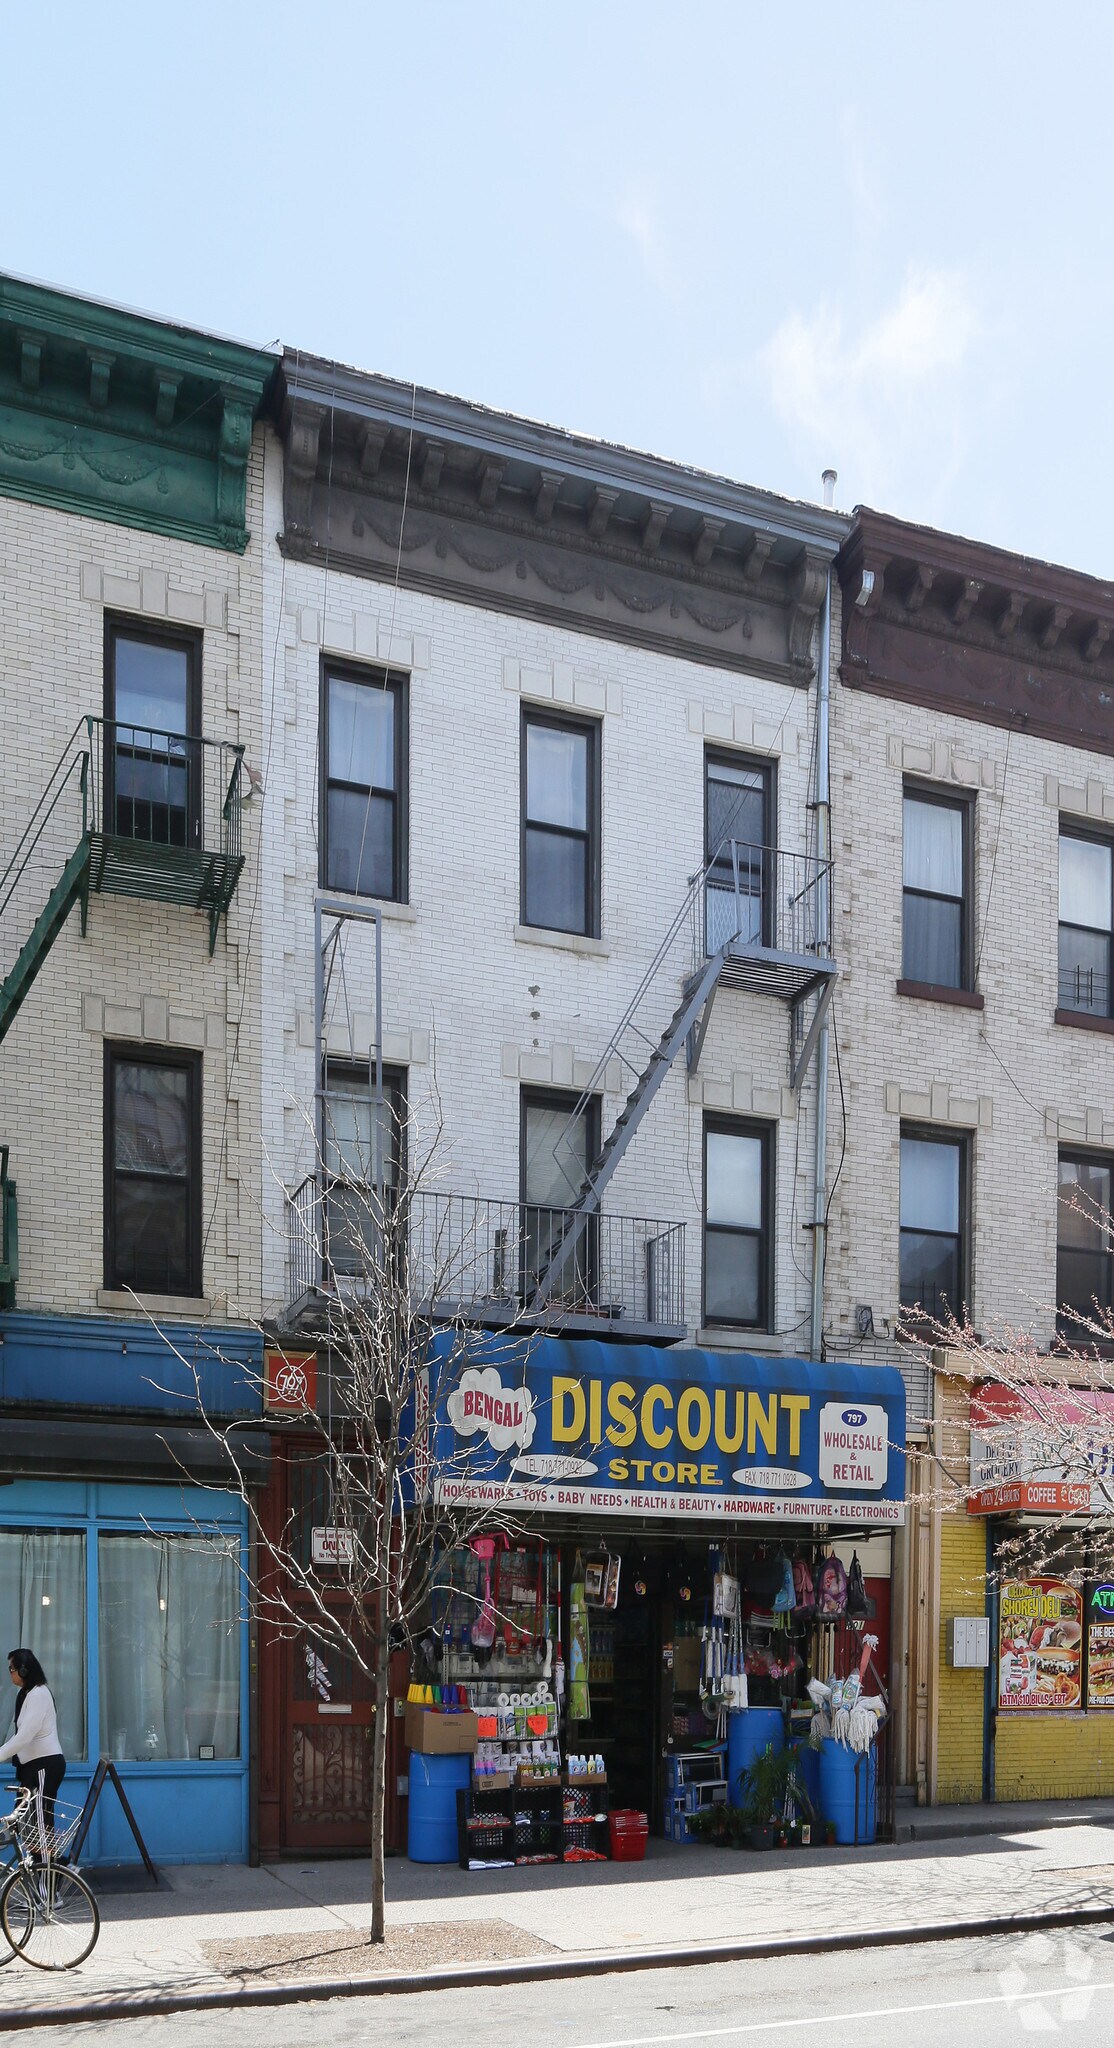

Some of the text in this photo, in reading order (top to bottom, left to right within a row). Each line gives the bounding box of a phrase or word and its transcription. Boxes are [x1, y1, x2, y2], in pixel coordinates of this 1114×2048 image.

[464, 1391, 523, 1428] BENGAL
[552, 1376, 811, 1456] DISCOUNT
[847, 1413, 862, 1424] 797
[824, 1431, 883, 1452] WHOLESALE
[850, 1452, 857, 1461] &
[525, 1458, 539, 1473] TEL.
[608, 1458, 723, 1486] STORE
[833, 1463, 874, 1482] RETAIL
[744, 1470, 797, 1486] FAX 718 771 0928
[981, 1491, 994, 1506] OPEN
[1027, 1486, 1057, 1503] COFFEE
[522, 1488, 547, 1502] TOYS
[558, 1491, 585, 1505] BABY
[590, 1493, 622, 1507] NEEDS
[630, 1496, 667, 1509] HEALTH
[670, 1499, 676, 1509] &
[679, 1498, 715, 1511] BEAUTY
[724, 1500, 775, 1514] HARDWARE
[783, 1502, 833, 1516] FURNITURE
[840, 1505, 899, 1519] ELECTRONICS
[1003, 1596, 1061, 1618] SHOREY DELI
[1091, 1626, 1103, 1638] THE
[1002, 1693, 1066, 1705] ATM $10 BILLS EBT
